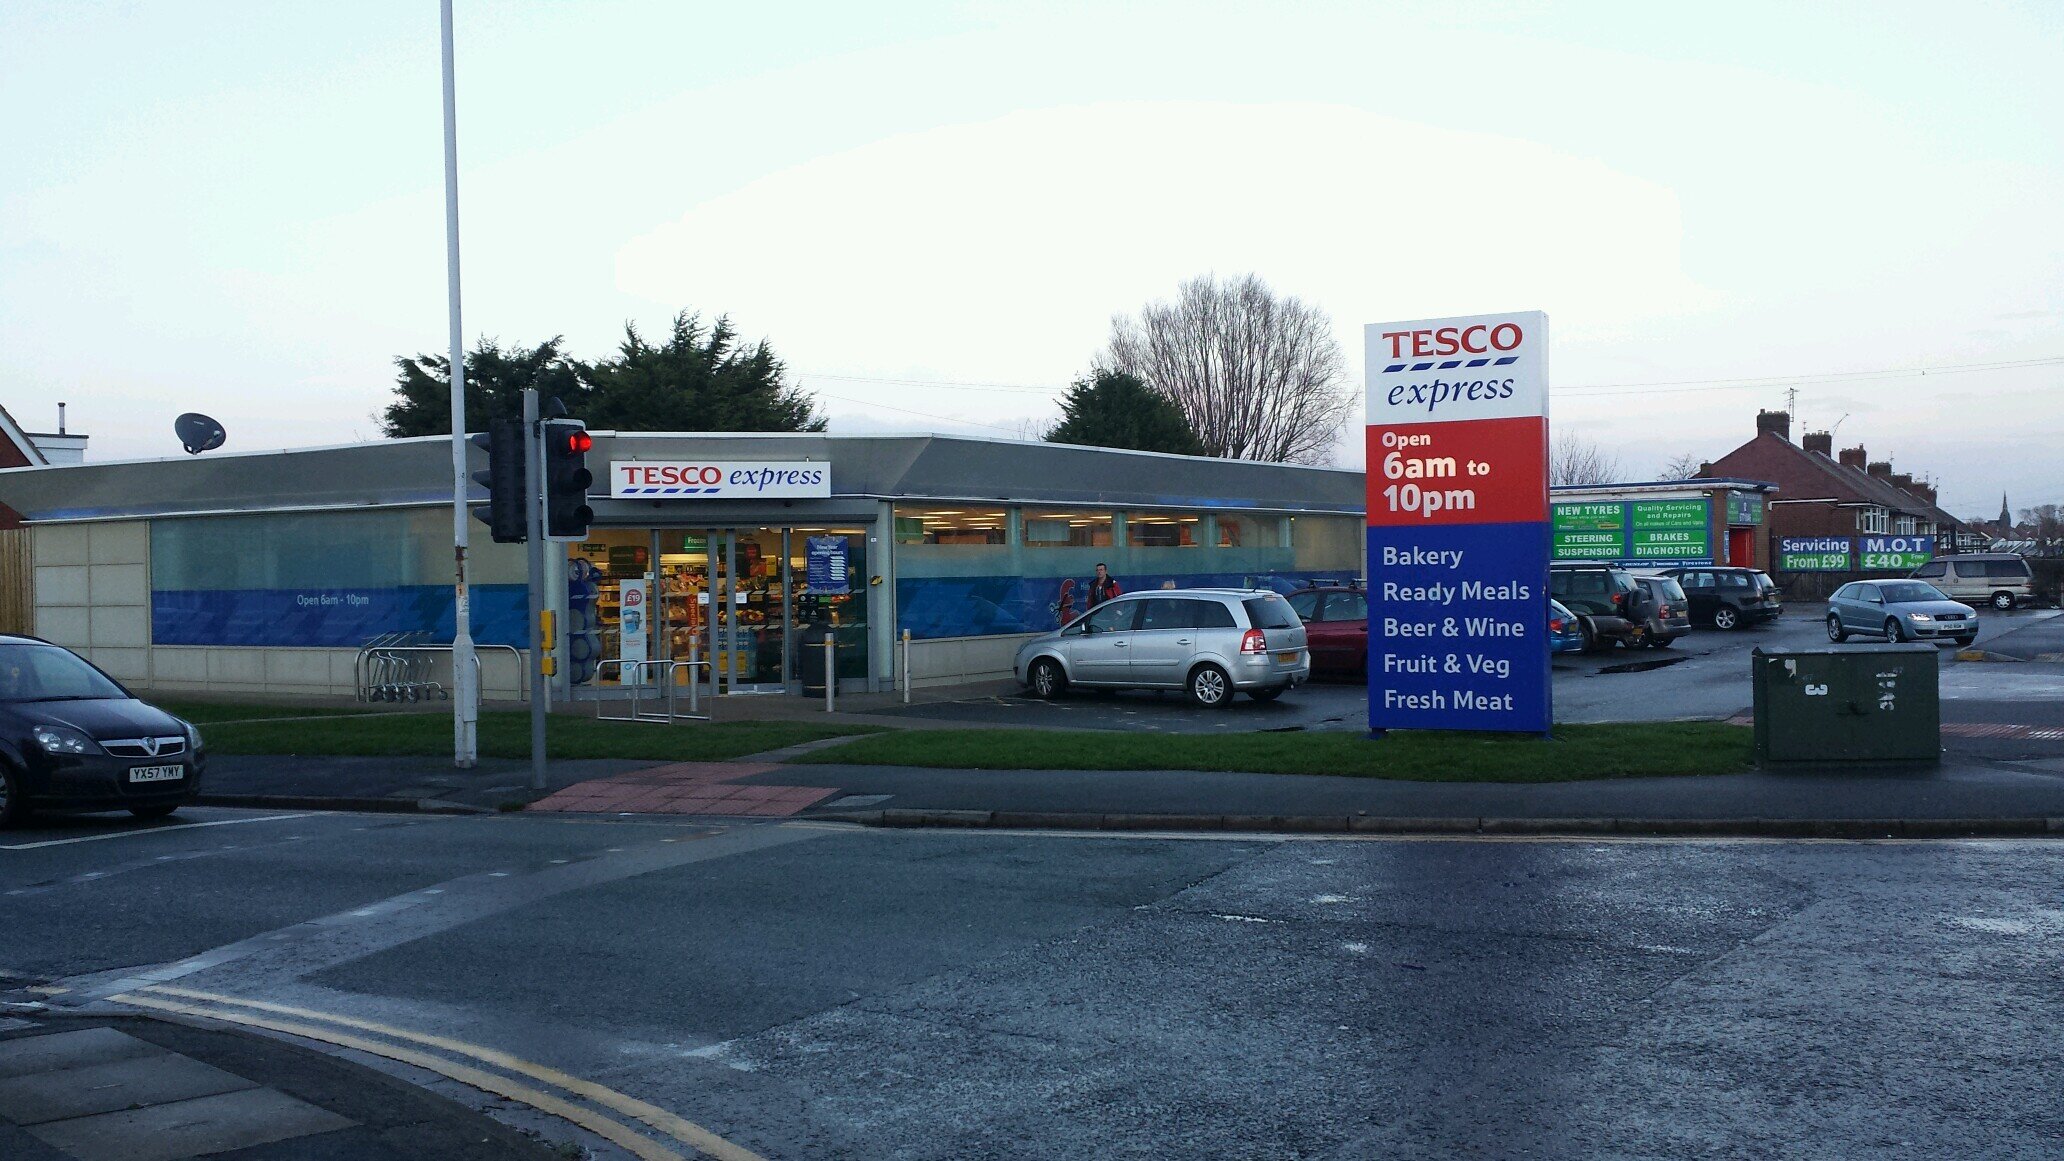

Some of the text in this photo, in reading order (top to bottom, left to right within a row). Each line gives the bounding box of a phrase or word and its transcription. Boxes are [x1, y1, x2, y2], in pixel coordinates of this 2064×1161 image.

[1382, 323, 1523, 359] TESCO
[1388, 378, 1514, 412] express
[1382, 432, 1431, 450] Open
[1383, 451, 1491, 480] 6am to
[621, 466, 822, 491] TESCO express
[1383, 484, 1476, 517] 10pm
[1666, 504, 1702, 512] Servicing
[1557, 505, 1620, 516] NEW TYRES
[1564, 534, 1613, 543] STEERING
[1650, 532, 1690, 541] BRAKES
[1558, 547, 1620, 556] SUSPENSION
[1636, 546, 1704, 555] DIAGNOSTICS
[1782, 538, 1849, 553] Servicing
[1867, 538, 1925, 552] M.O.T
[1383, 546, 1463, 569] Bakery
[1786, 555, 1845, 568] From £99
[1865, 554, 1902, 567] £40
[297, 594, 319, 607] Open
[320, 594, 338, 605] 6am
[346, 594, 369, 607] 10pm
[1383, 580, 1530, 605] Ready Meals
[689, 598, 698, 627] Special
[1384, 617, 1525, 637] Beer & Wine
[1384, 653, 1510, 678] Fruit & Veg
[1384, 690, 1514, 711] Fresh Meat
[133, 766, 179, 779] YX57 YMY
